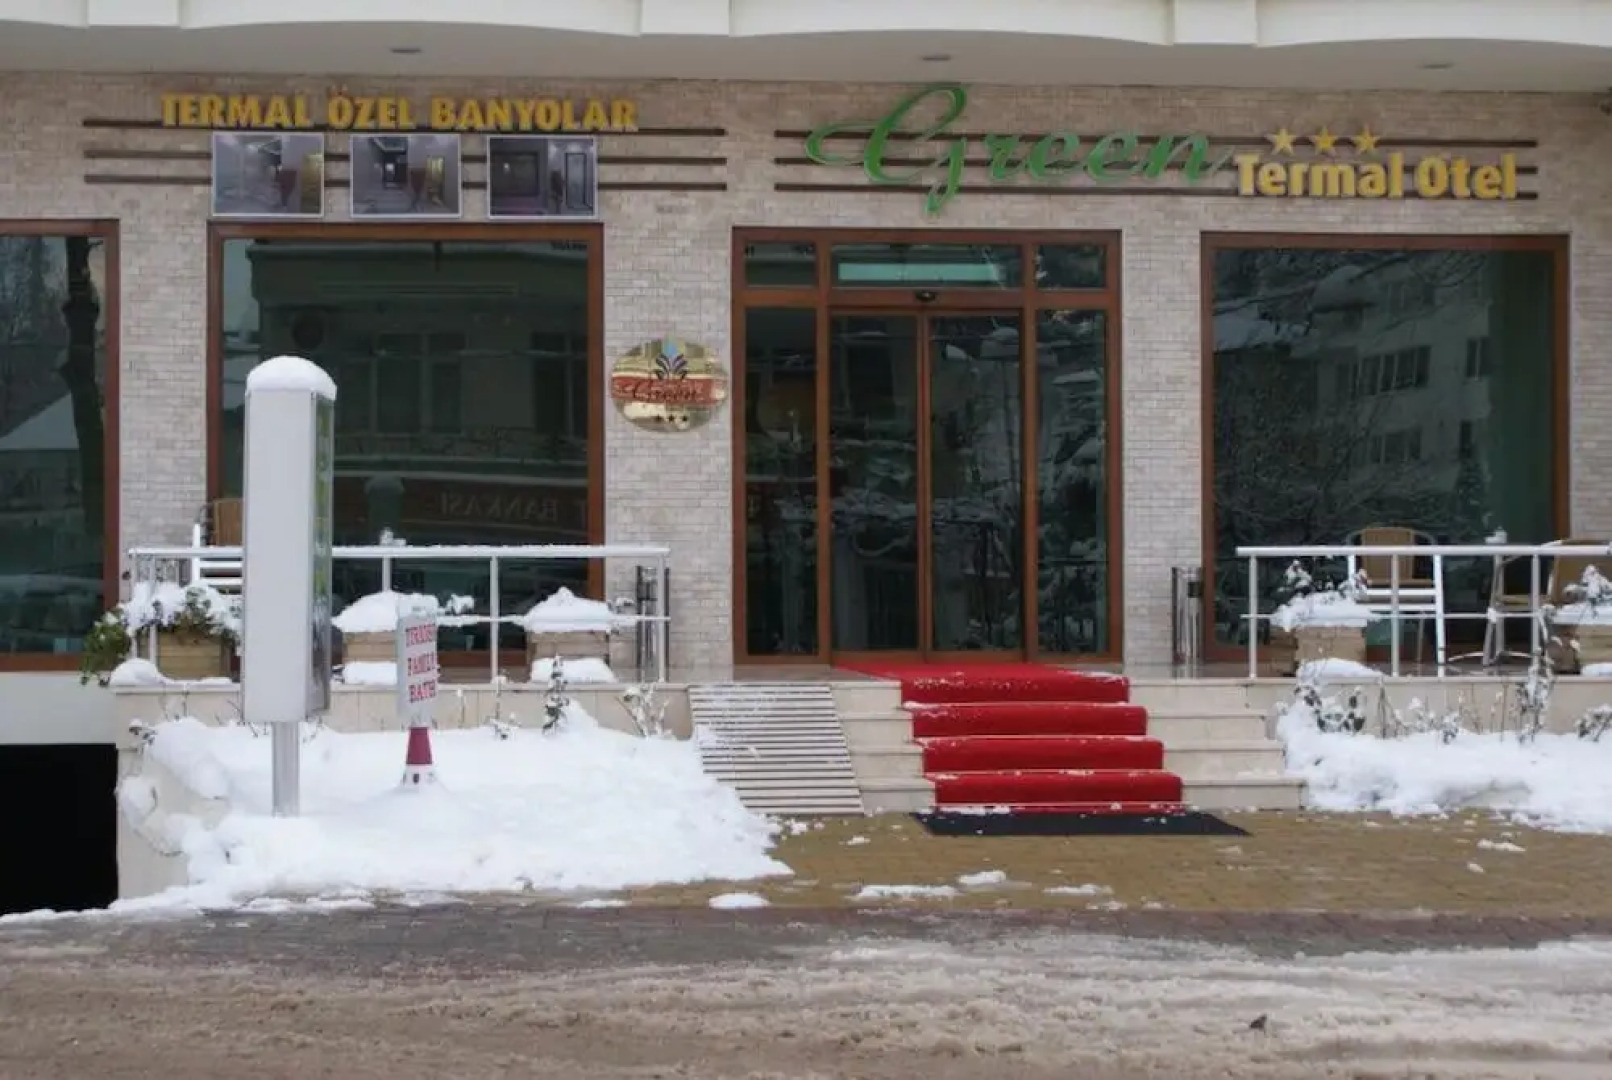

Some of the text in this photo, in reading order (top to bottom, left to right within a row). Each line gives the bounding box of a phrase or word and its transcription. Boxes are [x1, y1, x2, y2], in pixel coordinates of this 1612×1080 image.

[160, 85, 638, 132] TERMAL ÖZEL BANYOLAR
[804, 84, 1235, 215] Green
[1234, 152, 1517, 199] Termal Otel
